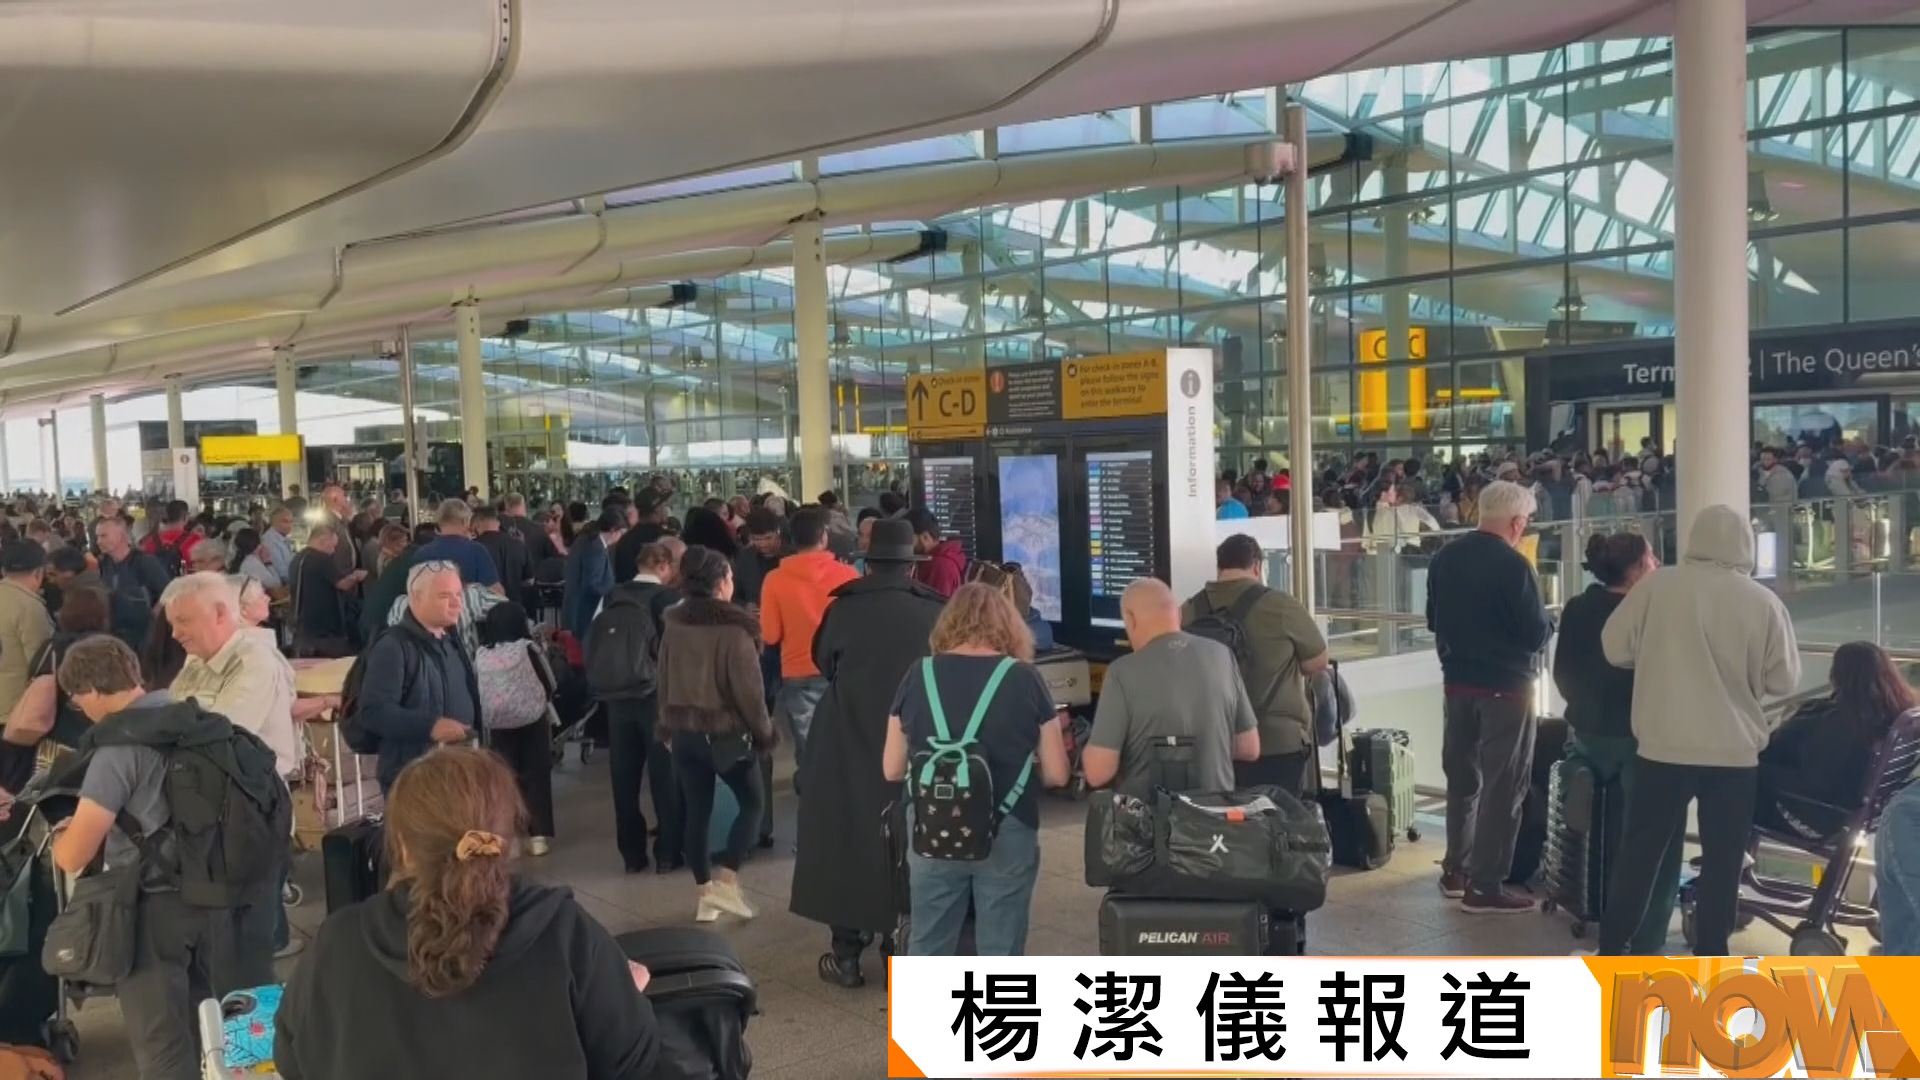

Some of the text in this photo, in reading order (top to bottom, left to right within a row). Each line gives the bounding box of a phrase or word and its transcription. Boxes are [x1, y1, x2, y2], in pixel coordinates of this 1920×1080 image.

[1622, 363, 1676, 384] Term
[1771, 350, 1816, 375] The
[938, 388, 976, 418] C-D
[1186, 406, 1198, 498] Information
[1138, 931, 1232, 945] PELICAN AIR
